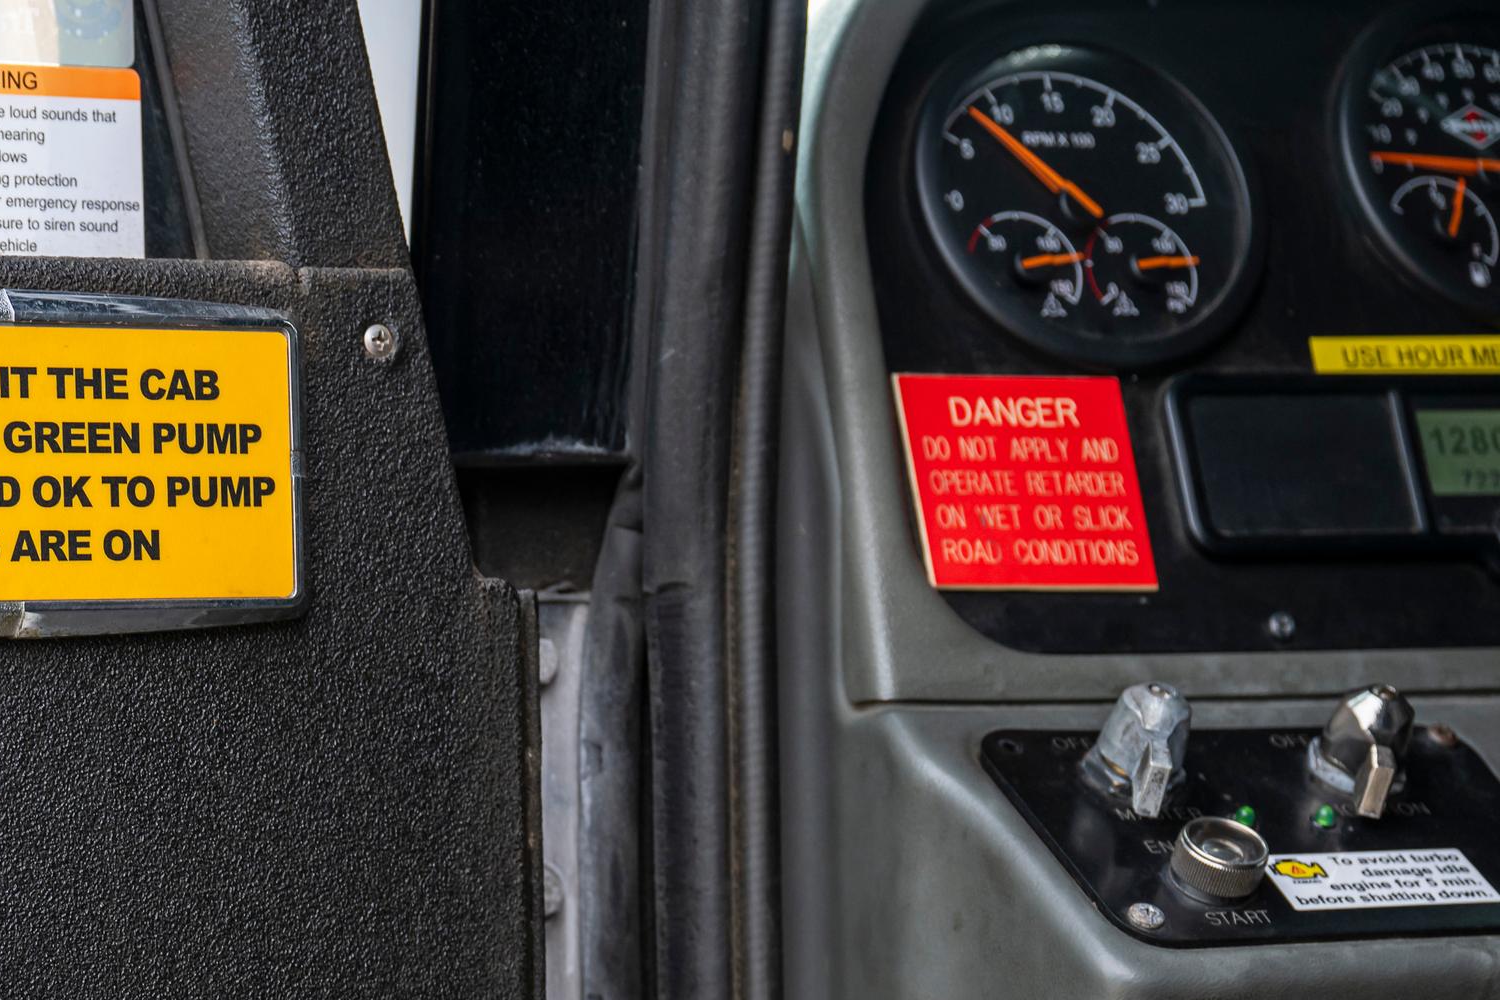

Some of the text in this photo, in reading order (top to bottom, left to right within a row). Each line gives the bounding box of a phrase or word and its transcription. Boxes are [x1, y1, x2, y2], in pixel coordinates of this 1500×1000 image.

[10, 106, 37, 121] loud
[42, 108, 88, 122] sounds
[92, 110, 116, 123] that
[14, 173, 77, 188] protection
[6, 196, 77, 212] emergency
[81, 198, 139, 212] response
[28, 219, 40, 231] to
[44, 218, 75, 232] siren
[80, 220, 118, 233] sound
[1342, 345, 1391, 368] USE
[1398, 345, 1464, 367] HOUR
[53, 367, 128, 400] THE
[139, 369, 220, 401] CAB
[947, 396, 1080, 428] DANGER
[3, 422, 141, 454] GREEN
[153, 423, 262, 455] PUMP
[923, 436, 1119, 463] DO NOT APPLY AND
[32, 475, 92, 508] OK
[101, 475, 155, 508] TO
[167, 475, 276, 508] PUMP
[930, 470, 1126, 496] OPERATE RETARDER
[936, 504, 1133, 531] ON WET OR SLICK
[11, 530, 92, 562] ARE
[103, 529, 160, 561] ON
[1014, 540, 1139, 566] CONDITIONS
[1329, 853, 1459, 865] To avoid turbo
[1362, 864, 1470, 877] damage idle
[1330, 881, 1392, 891] engine
[1396, 879, 1420, 888] for
[1426, 878, 1438, 887] 5
[1443, 876, 1481, 886] min.
[1296, 890, 1493, 905] before shutting down.
[1205, 909, 1273, 927] START
